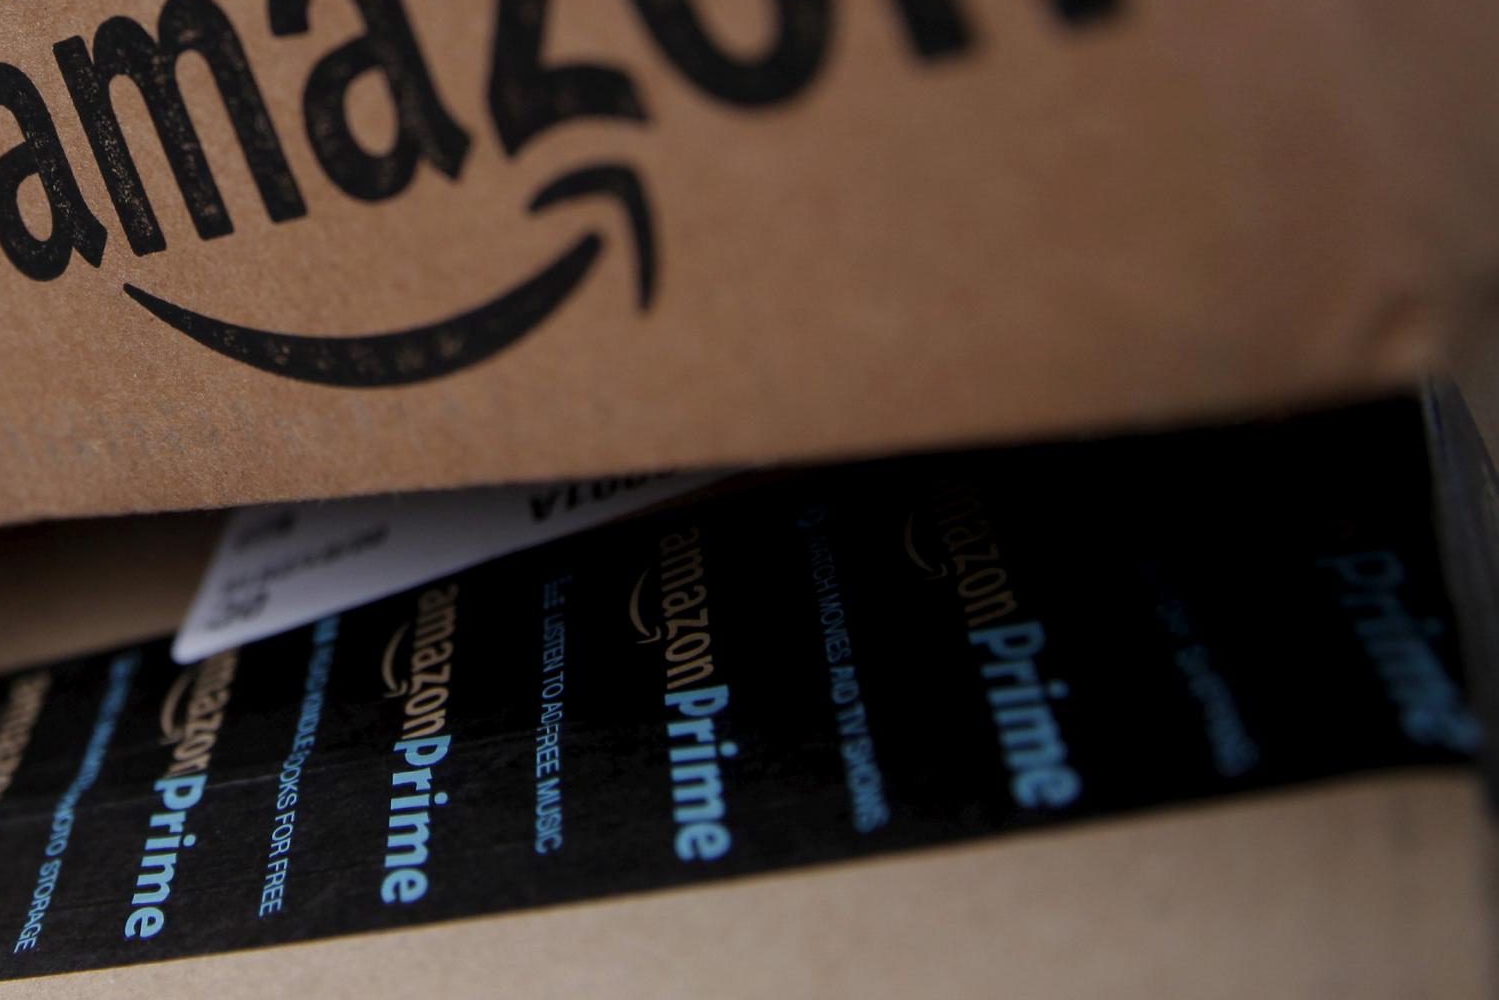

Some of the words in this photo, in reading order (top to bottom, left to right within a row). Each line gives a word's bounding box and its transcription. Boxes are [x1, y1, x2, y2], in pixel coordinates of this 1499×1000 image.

[541, 612, 567, 673] LISTEN
[819, 596, 853, 664] MOVIES
[541, 671, 565, 699] TO
[835, 700, 869, 737] TV
[268, 809, 296, 858] FOR
[535, 777, 564, 855] MUSIC
[12, 857, 62, 954] STORAGE
[258, 857, 289, 919] FREE
